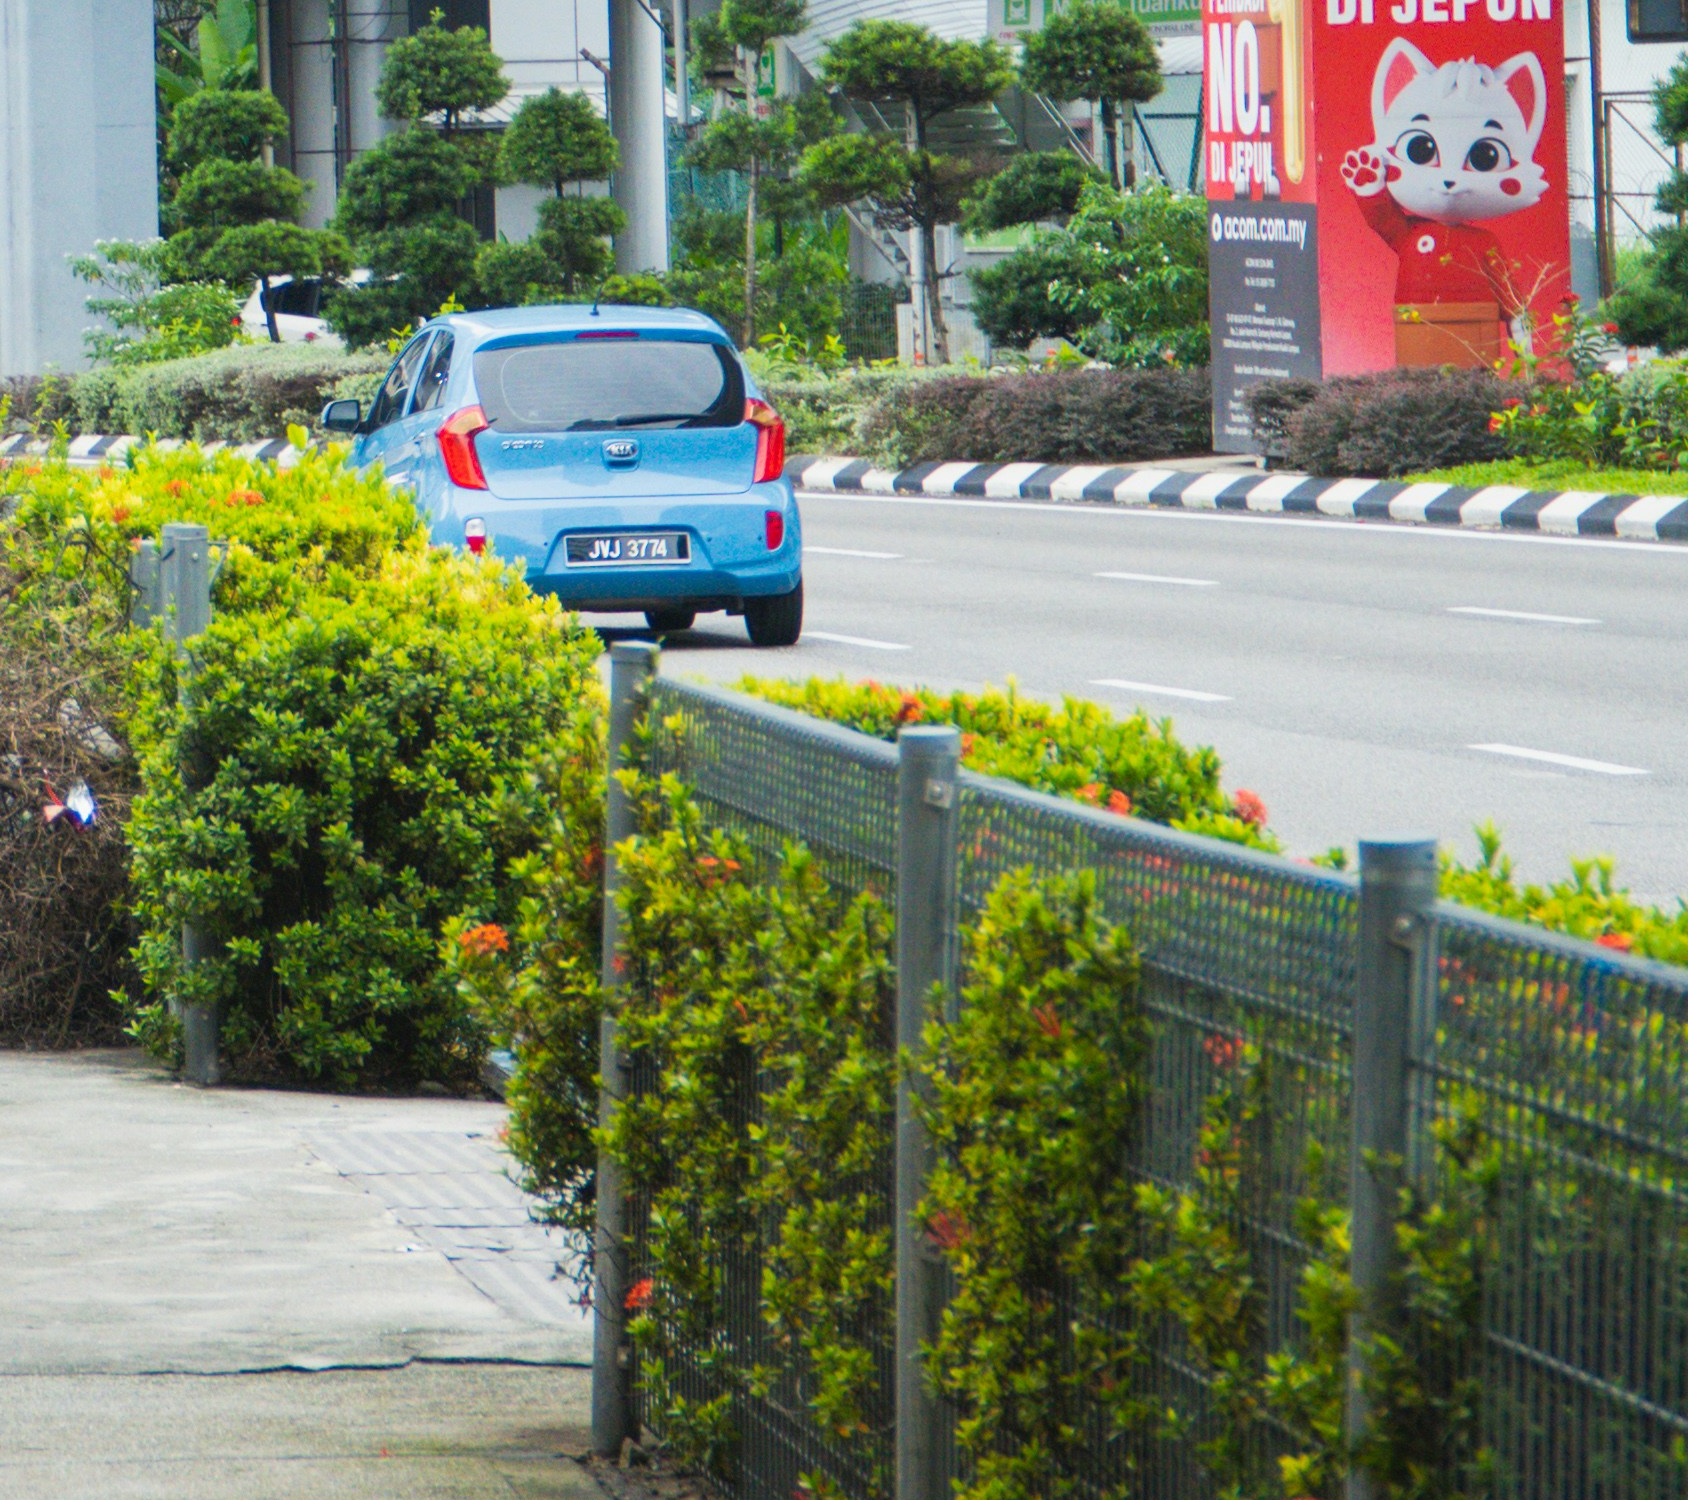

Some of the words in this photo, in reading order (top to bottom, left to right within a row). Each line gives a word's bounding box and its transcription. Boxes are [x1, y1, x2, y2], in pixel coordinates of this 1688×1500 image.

[1208, 19, 1271, 136] NO.
[1210, 140, 1226, 183] DI
[1228, 140, 1272, 184] JEPUN
[1223, 214, 1307, 250] acom.com.my
[588, 539, 622, 559] JVJ
[626, 538, 668, 559] 3774
